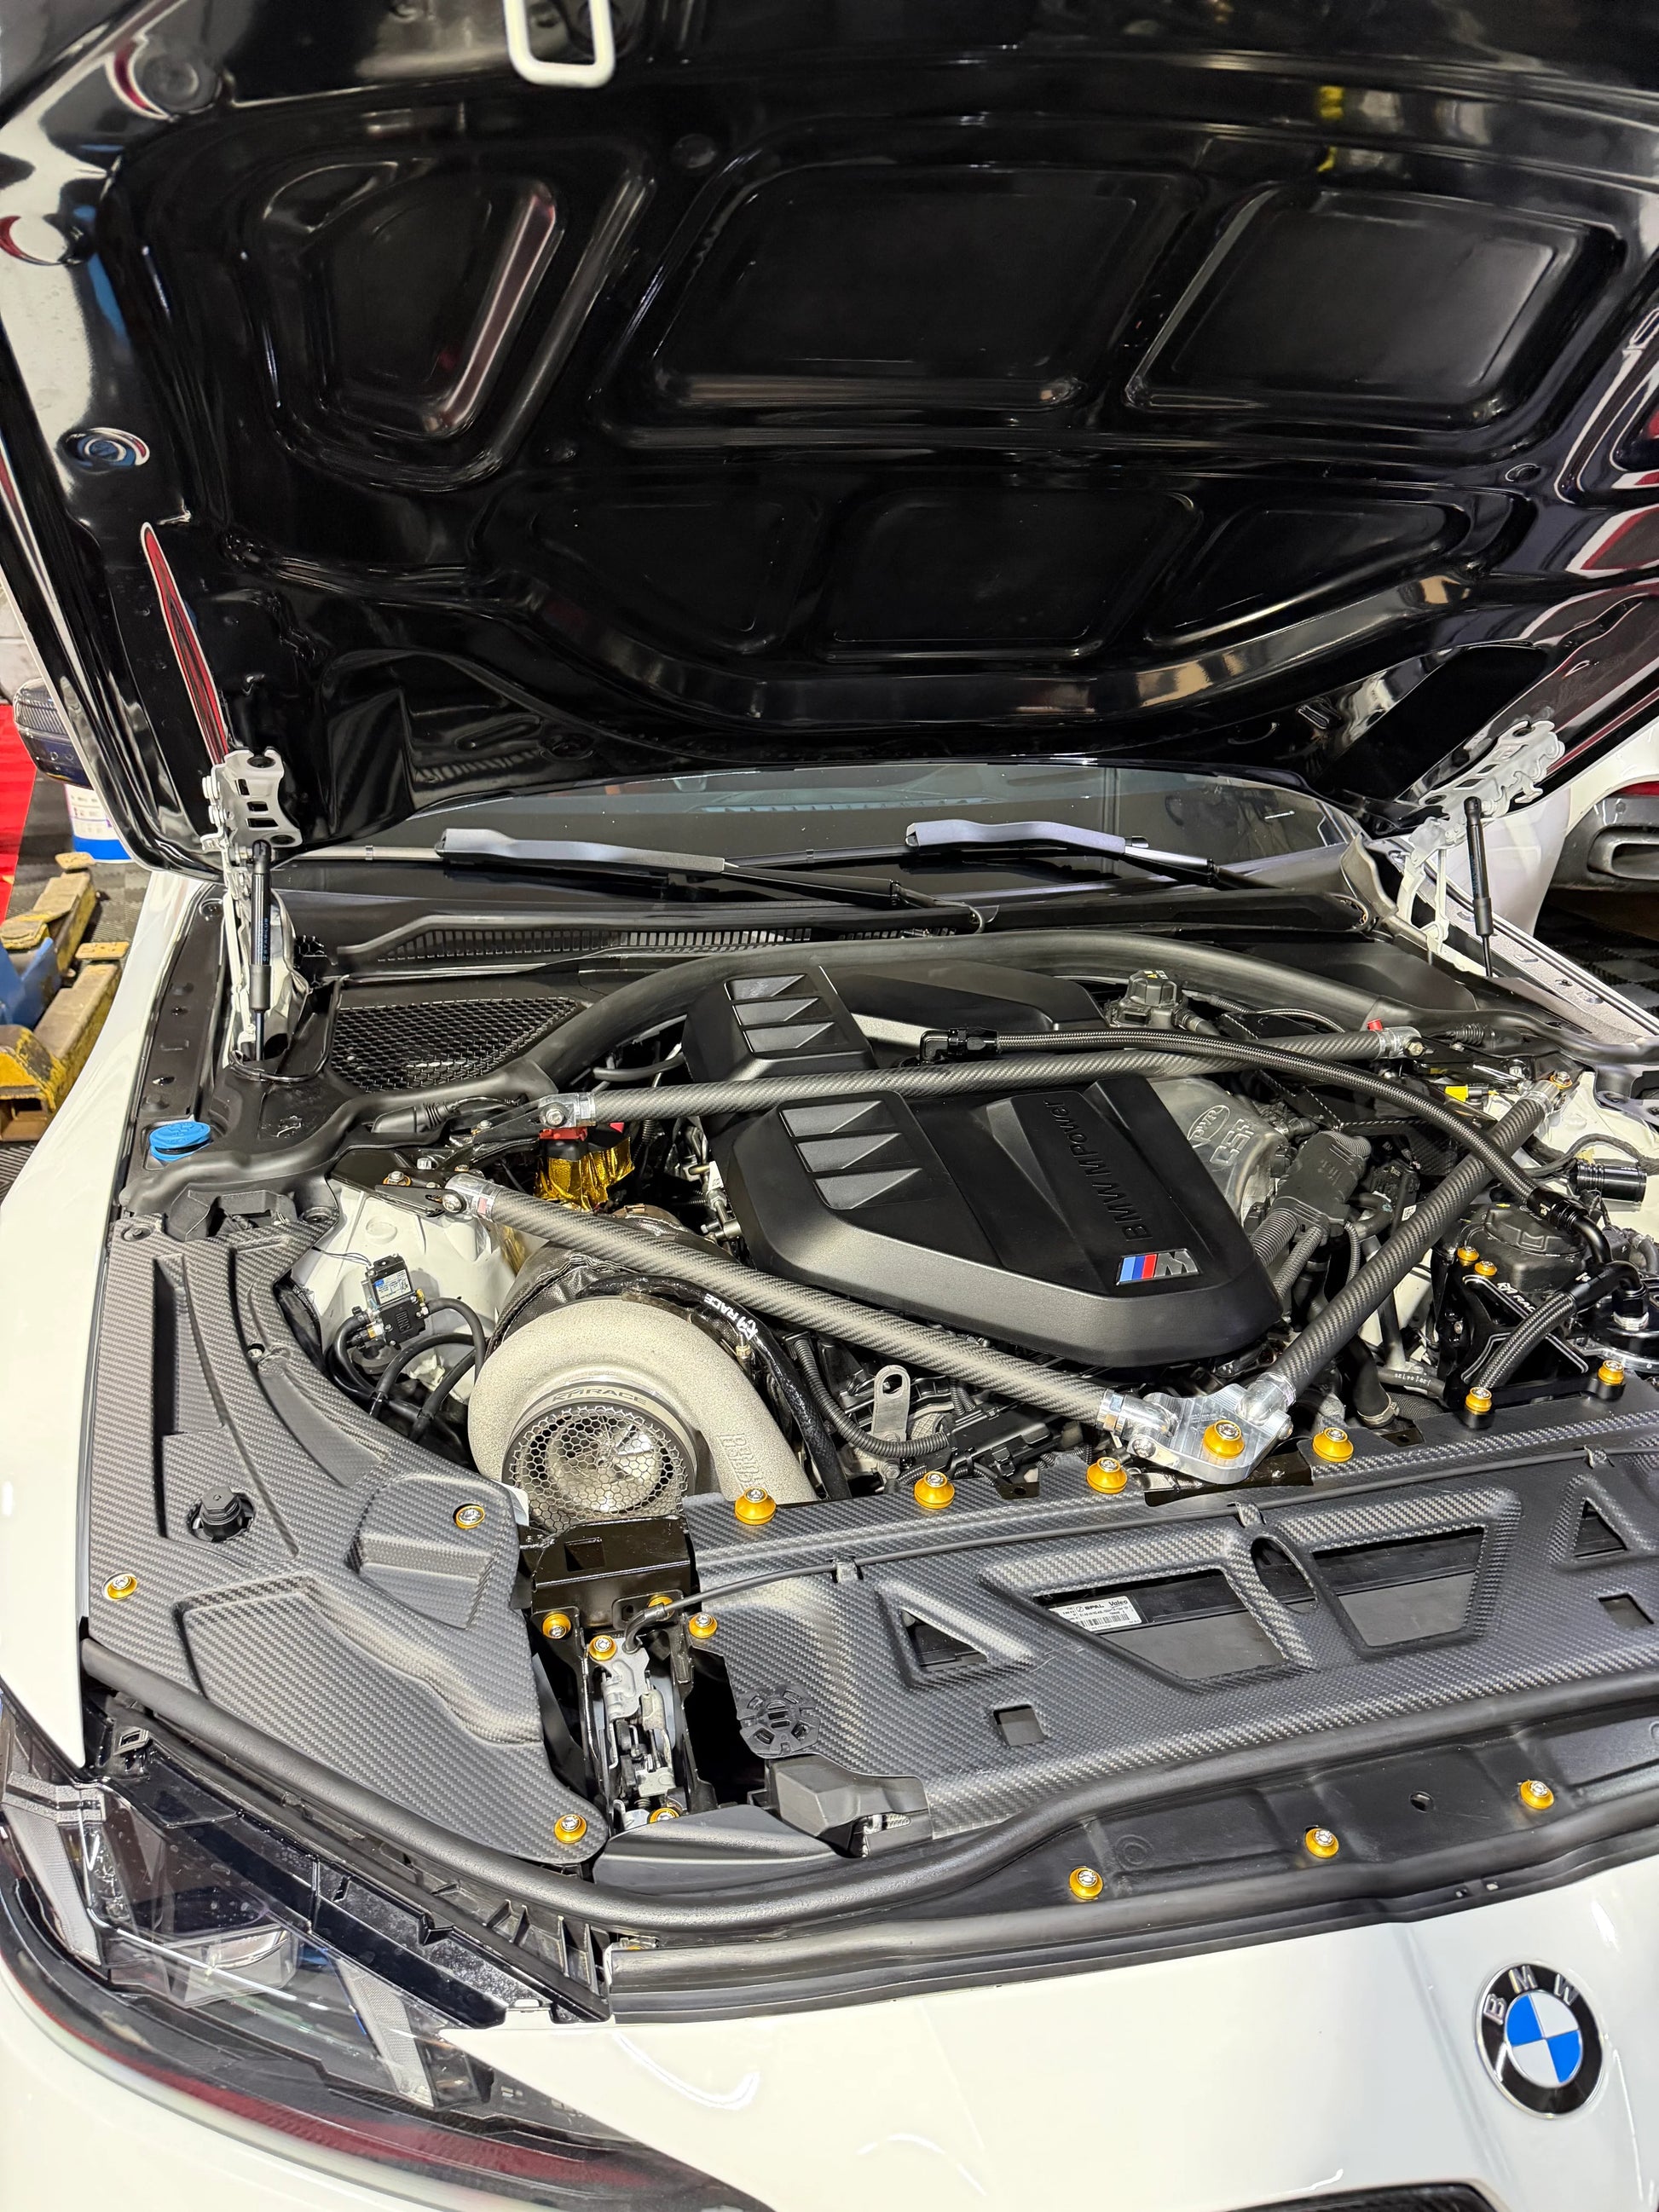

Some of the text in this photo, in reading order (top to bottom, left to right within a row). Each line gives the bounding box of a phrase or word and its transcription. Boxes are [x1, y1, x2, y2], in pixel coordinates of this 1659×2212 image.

[1190, 1109, 1219, 1142] PWR
[1210, 1118, 1254, 1166] CSF
[1043, 1100, 1153, 1241] BMW MPower
[1154, 1250, 1198, 1278] M
[704, 1293, 739, 1320] RACE
[1513, 1295, 1536, 1313] RAC
[586, 1389, 647, 1405] RACE
[1483, 1965, 1581, 2025] BMW
